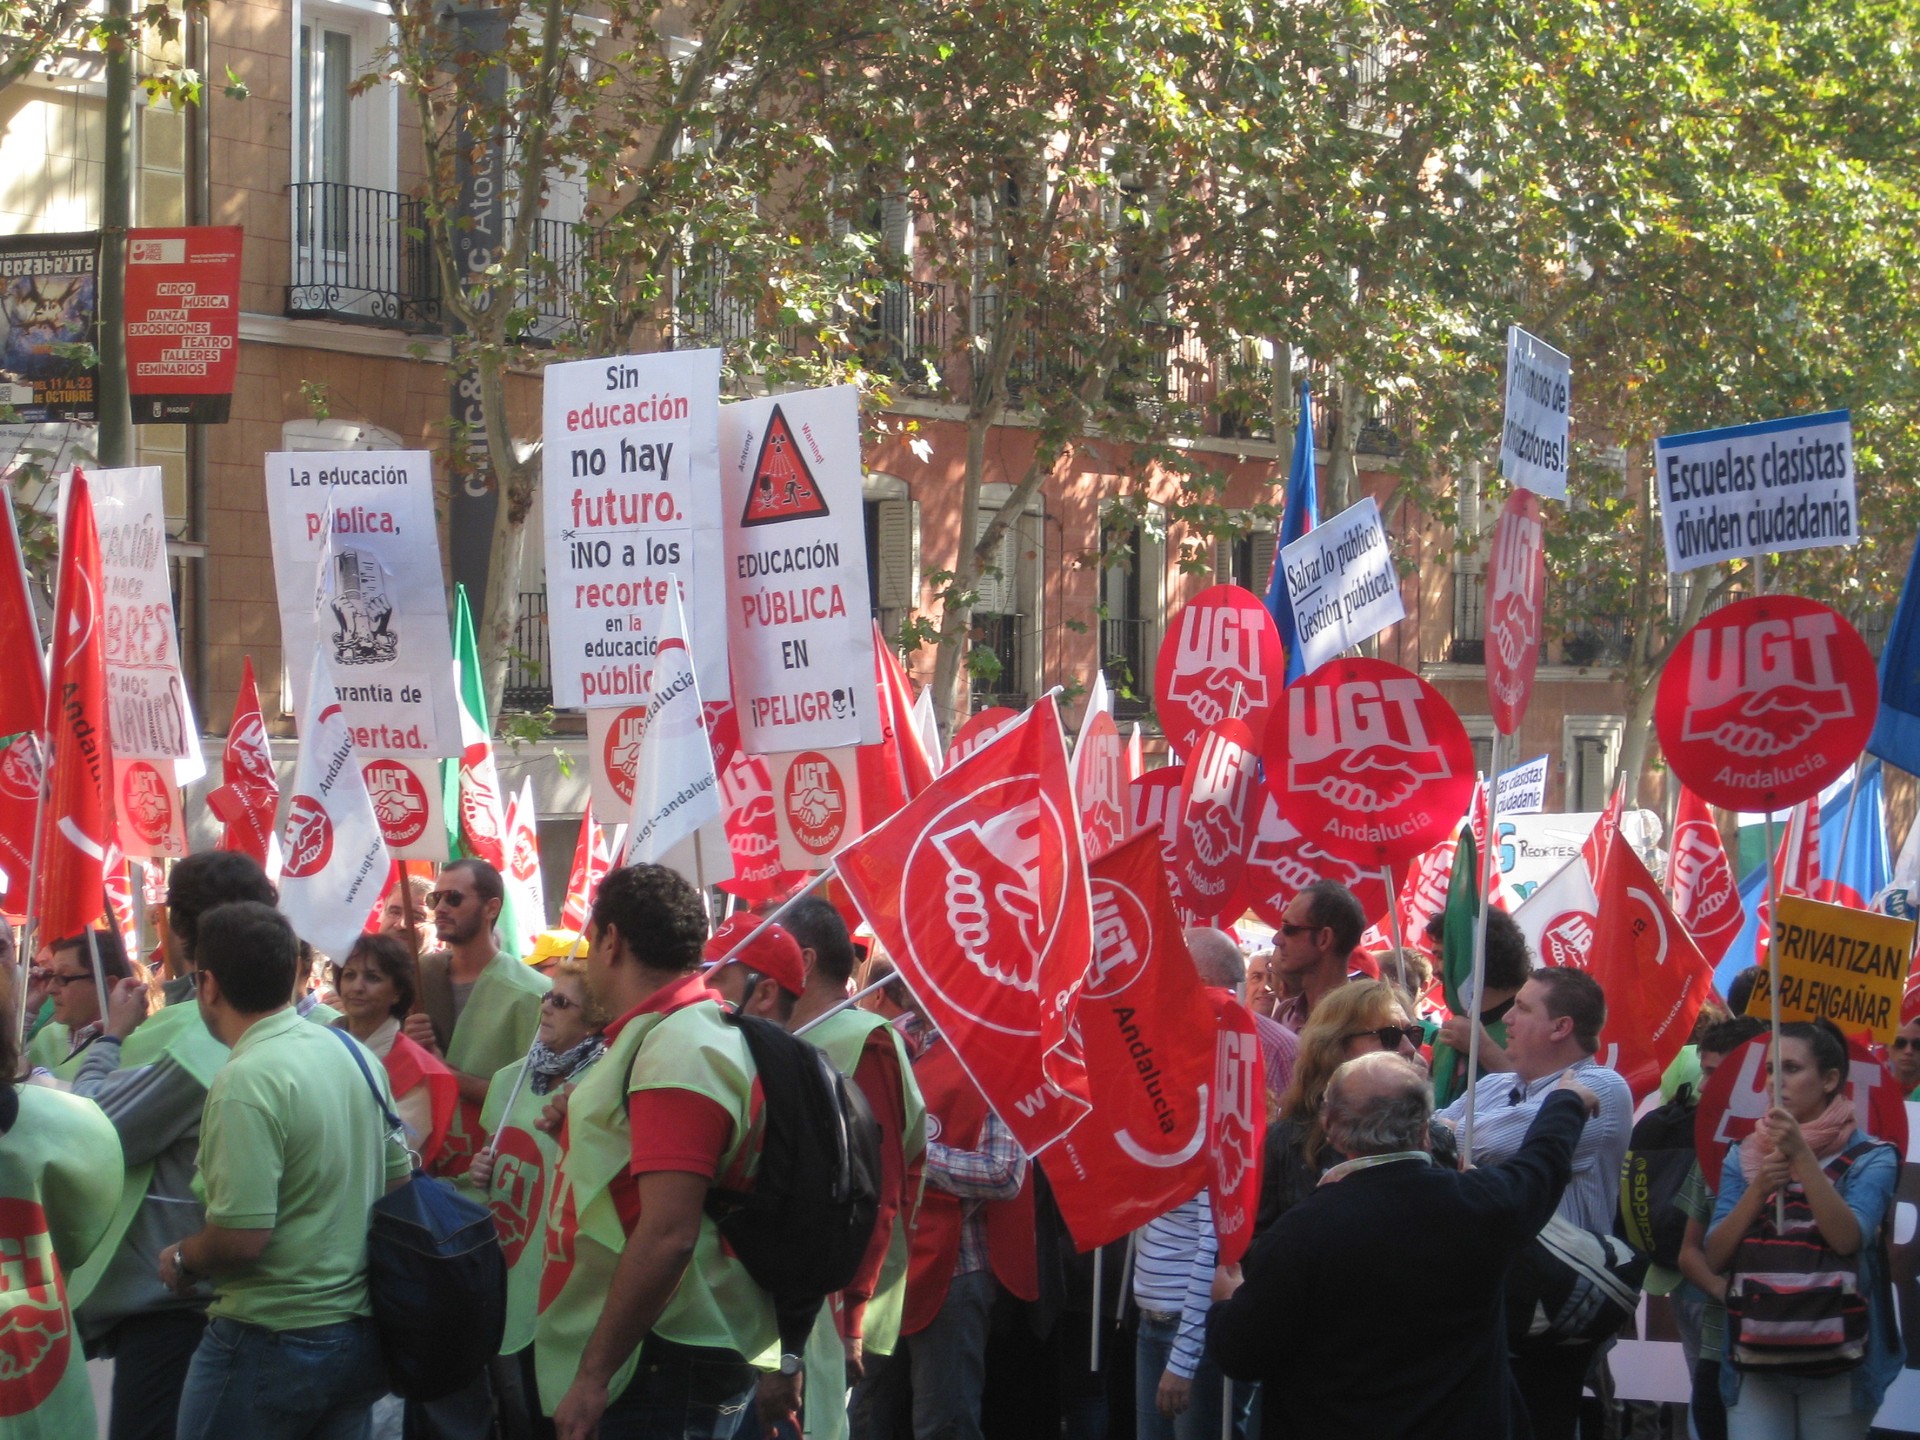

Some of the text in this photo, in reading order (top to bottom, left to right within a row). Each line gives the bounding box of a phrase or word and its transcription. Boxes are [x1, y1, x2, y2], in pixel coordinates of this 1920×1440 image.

[158, 284, 195, 296] CIRCO
[129, 323, 209, 335] EXPOSICIONES
[148, 310, 187, 322] DANZA
[163, 350, 218, 362] TALLERES
[183, 337, 231, 349] TEATRO
[79, 377, 92, 389] 23
[137, 363, 205, 376] SEMINARIOS
[606, 364, 639, 391] Sin
[46, 390, 94, 403] OCTUBRE
[566, 393, 688, 432] educación
[571, 437, 674, 481] no hay
[738, 430, 754, 472] Achtung!
[801, 422, 825, 465] Warning!
[290, 465, 408, 487] La educación
[1666, 436, 1846, 503] Escuelas clasistas
[306, 506, 401, 541] pblica,
[571, 488, 683, 528] futuro.
[1675, 488, 1851, 560] dividen ciudadanía
[622, 544, 635, 566] a
[646, 537, 680, 566] los
[737, 539, 840, 579] EDUCACIÓN
[1287, 514, 1383, 598] Salvar lo público!
[1495, 511, 1542, 606] UGT
[741, 584, 846, 629] PÚBLICA
[1297, 562, 1395, 645] Gestión pública!
[605, 614, 642, 632] en la
[1176, 605, 1266, 675] UGT
[584, 636, 658, 657] educació
[781, 639, 809, 670] EN
[1687, 612, 1840, 706] UGT
[335, 684, 422, 703] arantía de
[581, 663, 654, 704] públic
[1288, 678, 1431, 762] UGT
[365, 768, 411, 800] UGT
[792, 761, 831, 793] UGT
[1085, 734, 1121, 810] UGT
[1193, 730, 1258, 815] UGT
[1508, 767, 1544, 793] clasistas
[1712, 751, 1828, 789] Andalucía
[795, 826, 841, 848] Andalucía
[1323, 811, 1434, 844] Andalucía
[1184, 859, 1226, 896] Andalucía
[1766, 921, 1903, 981] PRIVATIZAN
[1804, 981, 1892, 1030] ENGAÑAR
[1112, 1005, 1176, 1135] Andalucía
[1632, 1172, 1656, 1252] adidas
